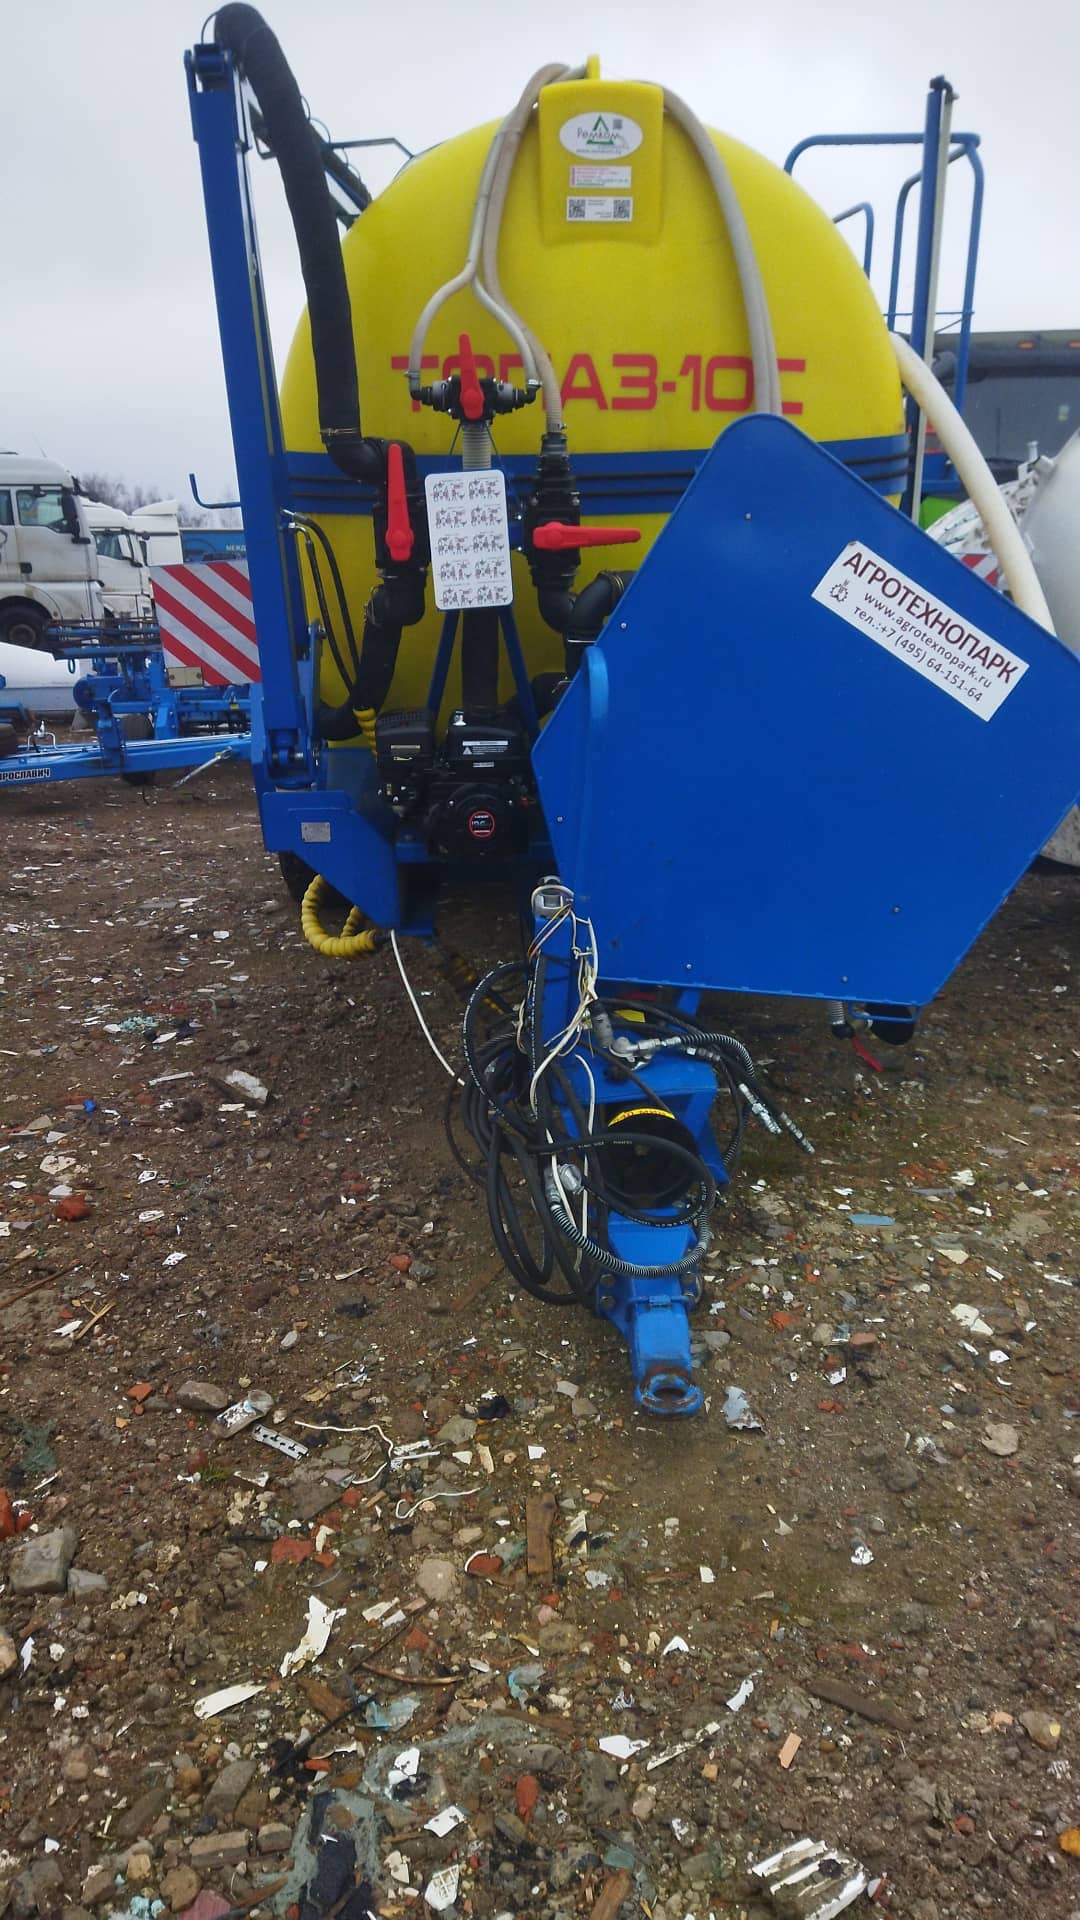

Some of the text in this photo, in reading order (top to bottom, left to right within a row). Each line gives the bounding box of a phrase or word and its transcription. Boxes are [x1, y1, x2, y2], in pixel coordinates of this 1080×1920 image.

[843, 552, 1018, 683] АГРОТЕХНОПАРК
[864, 591, 992, 689] www.agrotexnopark.ru
[893, 634, 927, 665] (495)
[926, 659, 983, 702] 64-151-64
[0, 768, 50, 781] РОСЛАВИЧ
